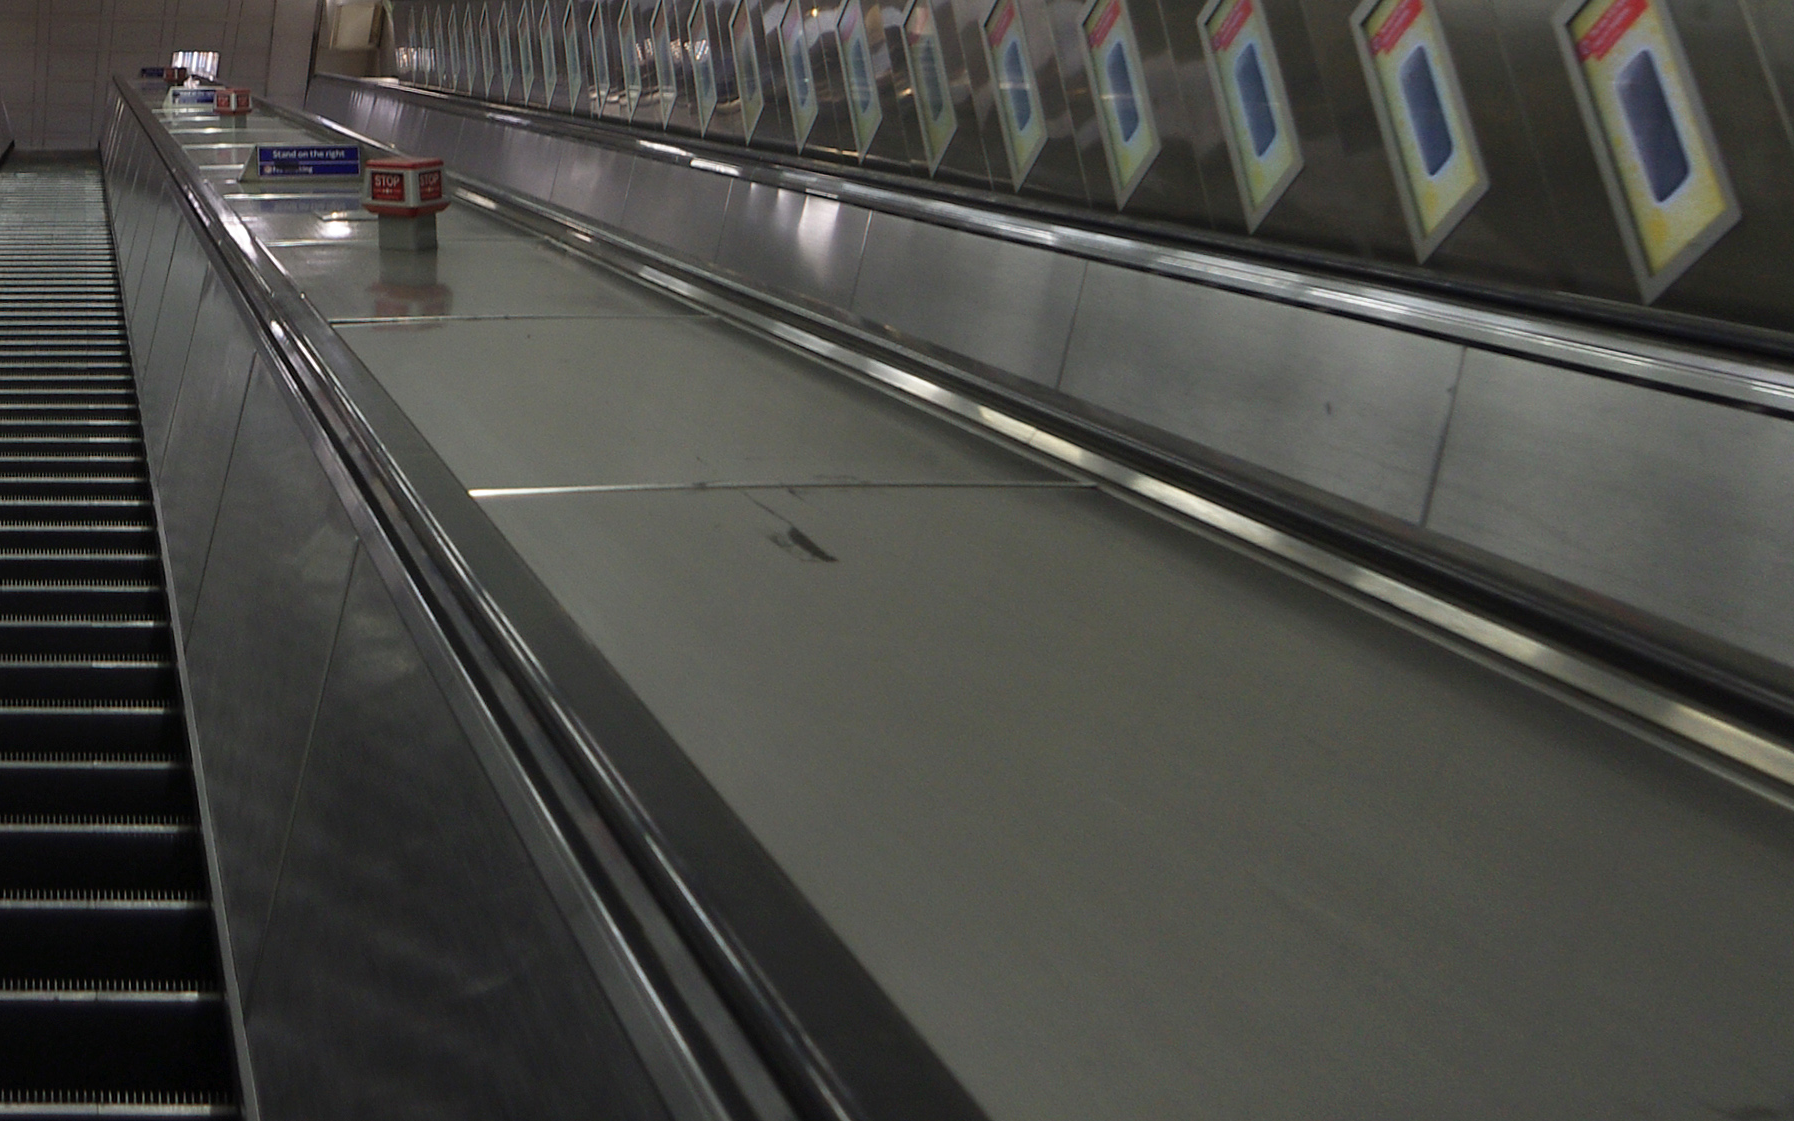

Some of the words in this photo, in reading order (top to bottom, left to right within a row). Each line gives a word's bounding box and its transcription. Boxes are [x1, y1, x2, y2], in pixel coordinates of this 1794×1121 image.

[272, 149, 296, 159] Stand
[310, 149, 324, 158] the
[326, 149, 345, 159] right
[375, 174, 400, 187] STOP
[419, 173, 440, 187] STOP
